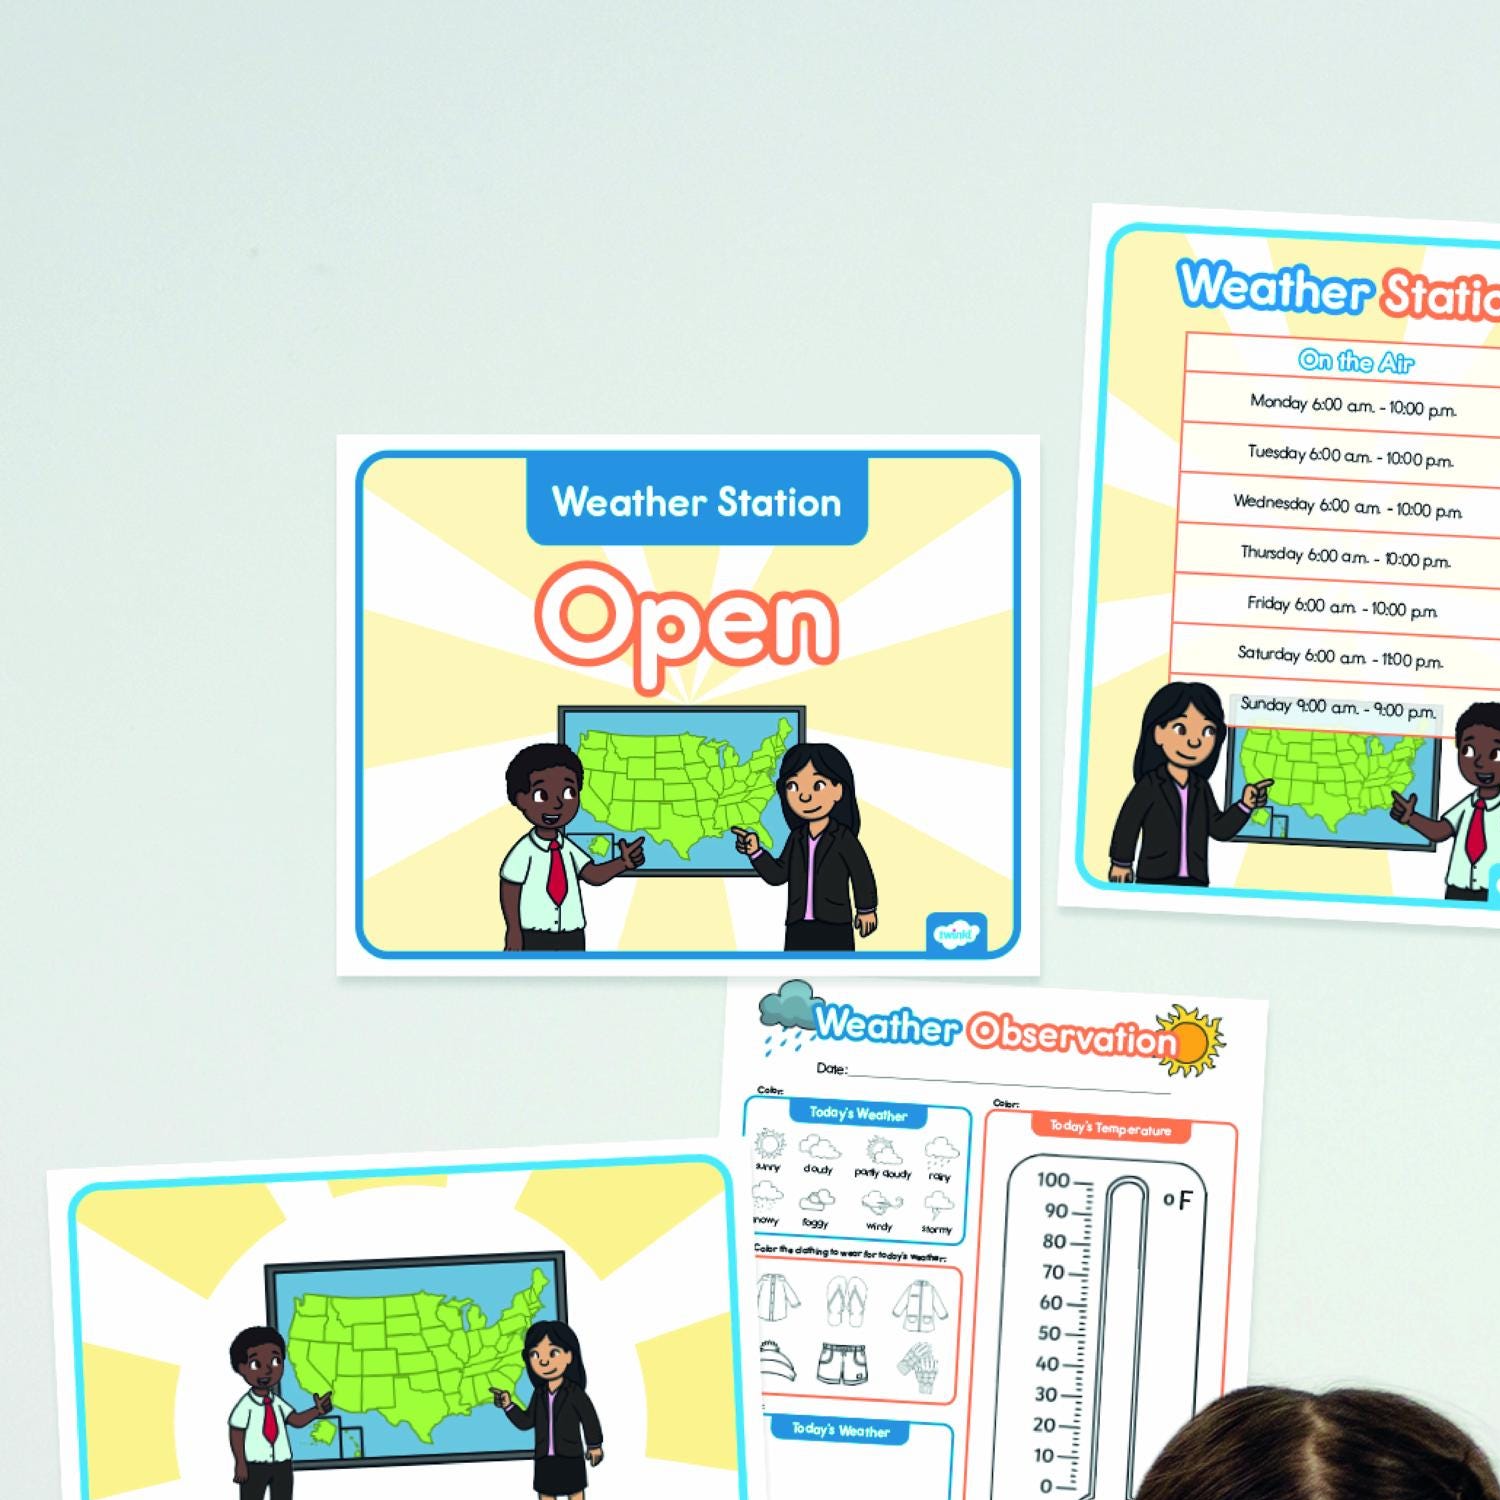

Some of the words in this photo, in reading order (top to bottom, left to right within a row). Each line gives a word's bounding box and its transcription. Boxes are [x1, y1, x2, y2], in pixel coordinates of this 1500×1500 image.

[1177, 258, 1376, 316] Weather
[1298, 348, 1331, 370] On
[1337, 349, 1374, 373] the
[1378, 352, 1415, 374] Air
[1250, 393, 1307, 413] Monday
[1312, 397, 1342, 411] 6:00
[1390, 400, 1424, 416] 10:00
[1248, 444, 1306, 464] Tuesday
[1309, 447, 1341, 462] 6:00
[1387, 451, 1423, 466] 10:00
[552, 484, 708, 518] Weather
[717, 485, 842, 518] Station
[1234, 494, 1315, 515] Wednesday
[1319, 498, 1349, 513] 6:00
[1397, 502, 1431, 518] 10:00
[1241, 545, 1304, 564] Thursday
[1307, 548, 1338, 563] 6:00
[1385, 551, 1420, 567] 10:00
[1247, 595, 1291, 613] Friday
[1295, 597, 1325, 613] 6:00
[1372, 601, 1407, 617] 10:00
[534, 560, 840, 698] Open
[1238, 645, 1301, 665] Saturday
[1305, 649, 1335, 664] 6:00
[1241, 696, 1292, 715] Sunday
[1296, 698, 1327, 714] 9:00
[1374, 702, 1404, 717] 9:00
[939, 928, 972, 940] twinkl
[814, 1001, 963, 1047] Weather
[966, 1010, 1179, 1061] Observation
[816, 1061, 849, 1077] Date:
[757, 1085, 785, 1096] Color:
[992, 1098, 1020, 1109] Color:
[810, 1106, 854, 1123] Today's
[856, 1107, 908, 1122] Weather
[1050, 1118, 1093, 1136] Today's
[1095, 1121, 1172, 1138] Temperature
[803, 1165, 834, 1176] cloudy
[854, 1167, 880, 1180] partly
[882, 1168, 913, 1181] cloudy
[1038, 1171, 1070, 1188] 100
[1045, 1204, 1069, 1219] 90
[753, 1216, 780, 1228] nowy
[802, 1218, 829, 1230] foggy
[921, 1224, 953, 1236] stormy
[1043, 1234, 1067, 1250] 80
[779, 1245, 793, 1254] the
[795, 1246, 829, 1258] clothing
[830, 1248, 839, 1256] to
[863, 1249, 877, 1259] for
[878, 1251, 908, 1262] today's
[910, 1253, 947, 1263] weather:
[1043, 1265, 1066, 1280] 70
[1040, 1296, 1063, 1311] 60
[1038, 1326, 1061, 1341] 50
[1036, 1356, 1060, 1372] 40
[1035, 1387, 1058, 1403] 30
[792, 1421, 837, 1439] Today's
[839, 1424, 890, 1440] Weather
[1033, 1418, 1057, 1433] 20
[1035, 1448, 1055, 1463] 10
[1040, 1479, 1053, 1494] 0
